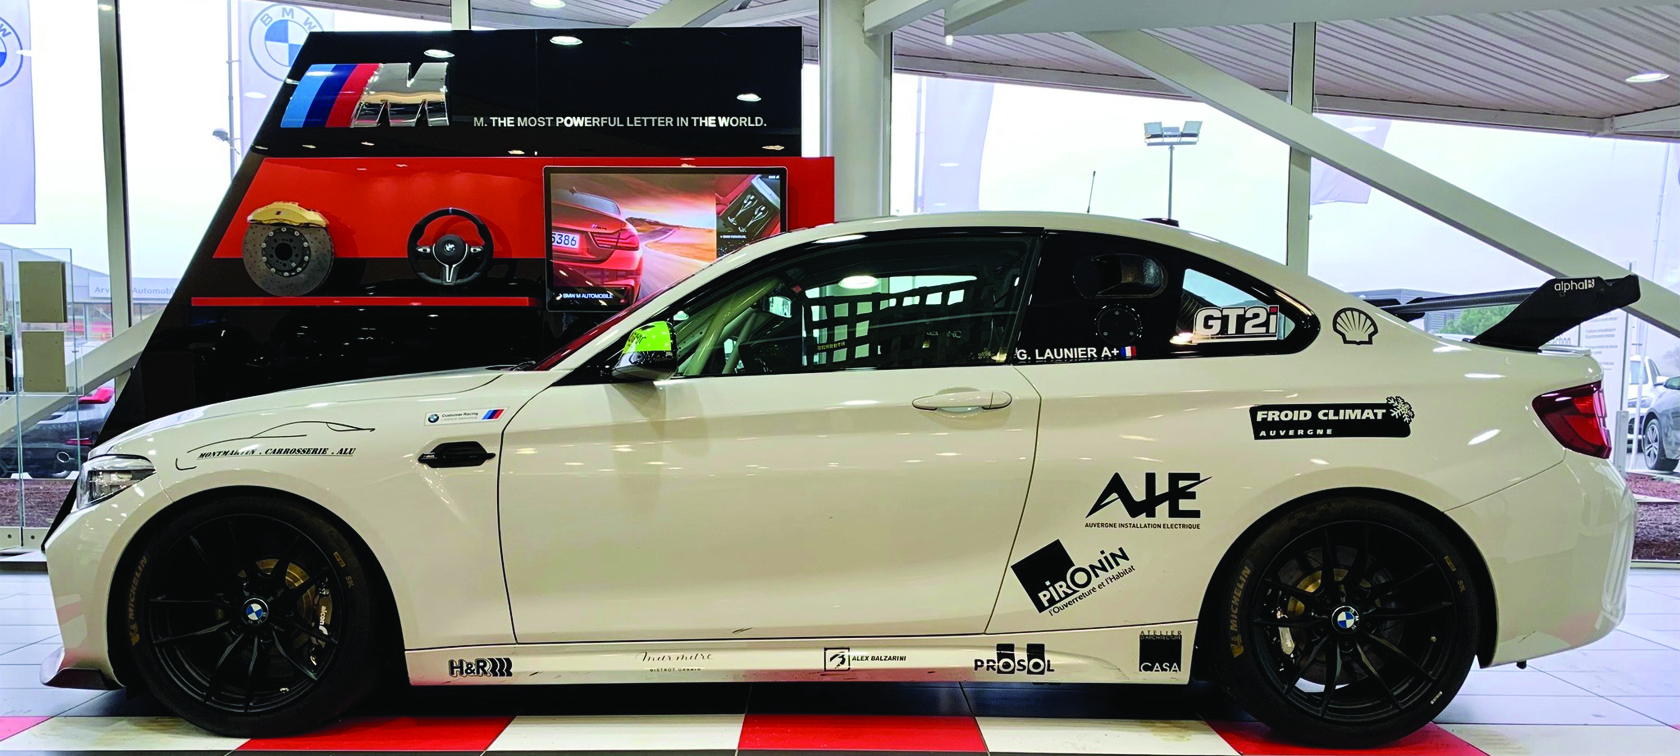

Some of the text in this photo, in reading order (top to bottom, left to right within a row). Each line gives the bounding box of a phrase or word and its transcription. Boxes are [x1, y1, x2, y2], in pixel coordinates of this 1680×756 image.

[260, 7, 317, 31] BMW
[473, 116, 767, 127] M. THE MOST POWERFUL LETTER IN THE WORLD.
[1194, 305, 1278, 336] GT2i
[1035, 347, 1098, 360] LAUNIER
[1256, 409, 1387, 422] FROID CLIMAT
[1259, 428, 1334, 437] AUVERGNE
[264, 447, 330, 456] CARROSSERIE
[336, 447, 357, 456] ALU
[1085, 472, 1212, 519] AIE
[1118, 522, 1162, 530] INSTALLATION
[125, 555, 147, 621] MICHELIN
[1230, 565, 1252, 632] MICHELIN
[319, 605, 328, 626] alcon
[448, 658, 491, 678] H&R
[974, 656, 1055, 674] PROSOL
[1140, 662, 1180, 673] CASA
